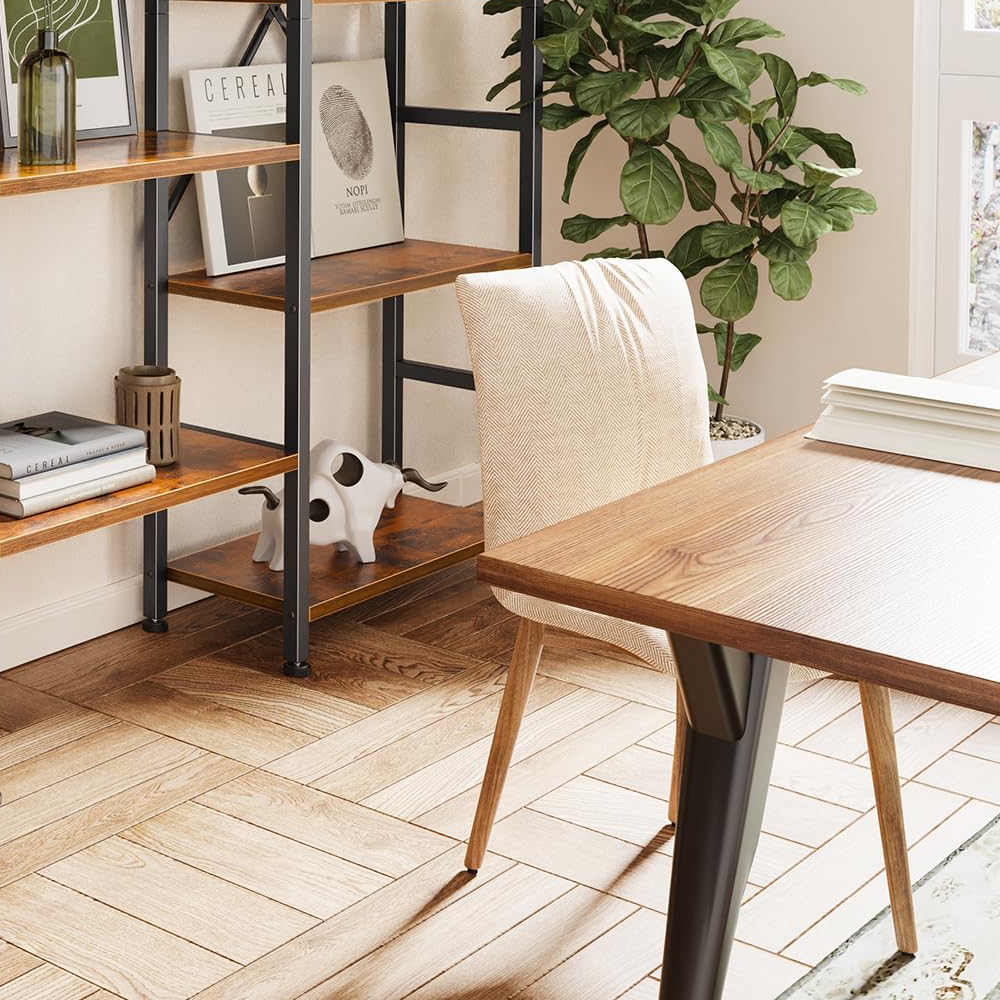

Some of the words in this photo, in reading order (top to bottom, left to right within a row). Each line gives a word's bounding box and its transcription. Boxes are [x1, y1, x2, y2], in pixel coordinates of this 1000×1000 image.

[204, 72, 287, 103] CEREAL
[346, 184, 369, 198] NOPI
[26, 455, 70, 474] CEREAL
